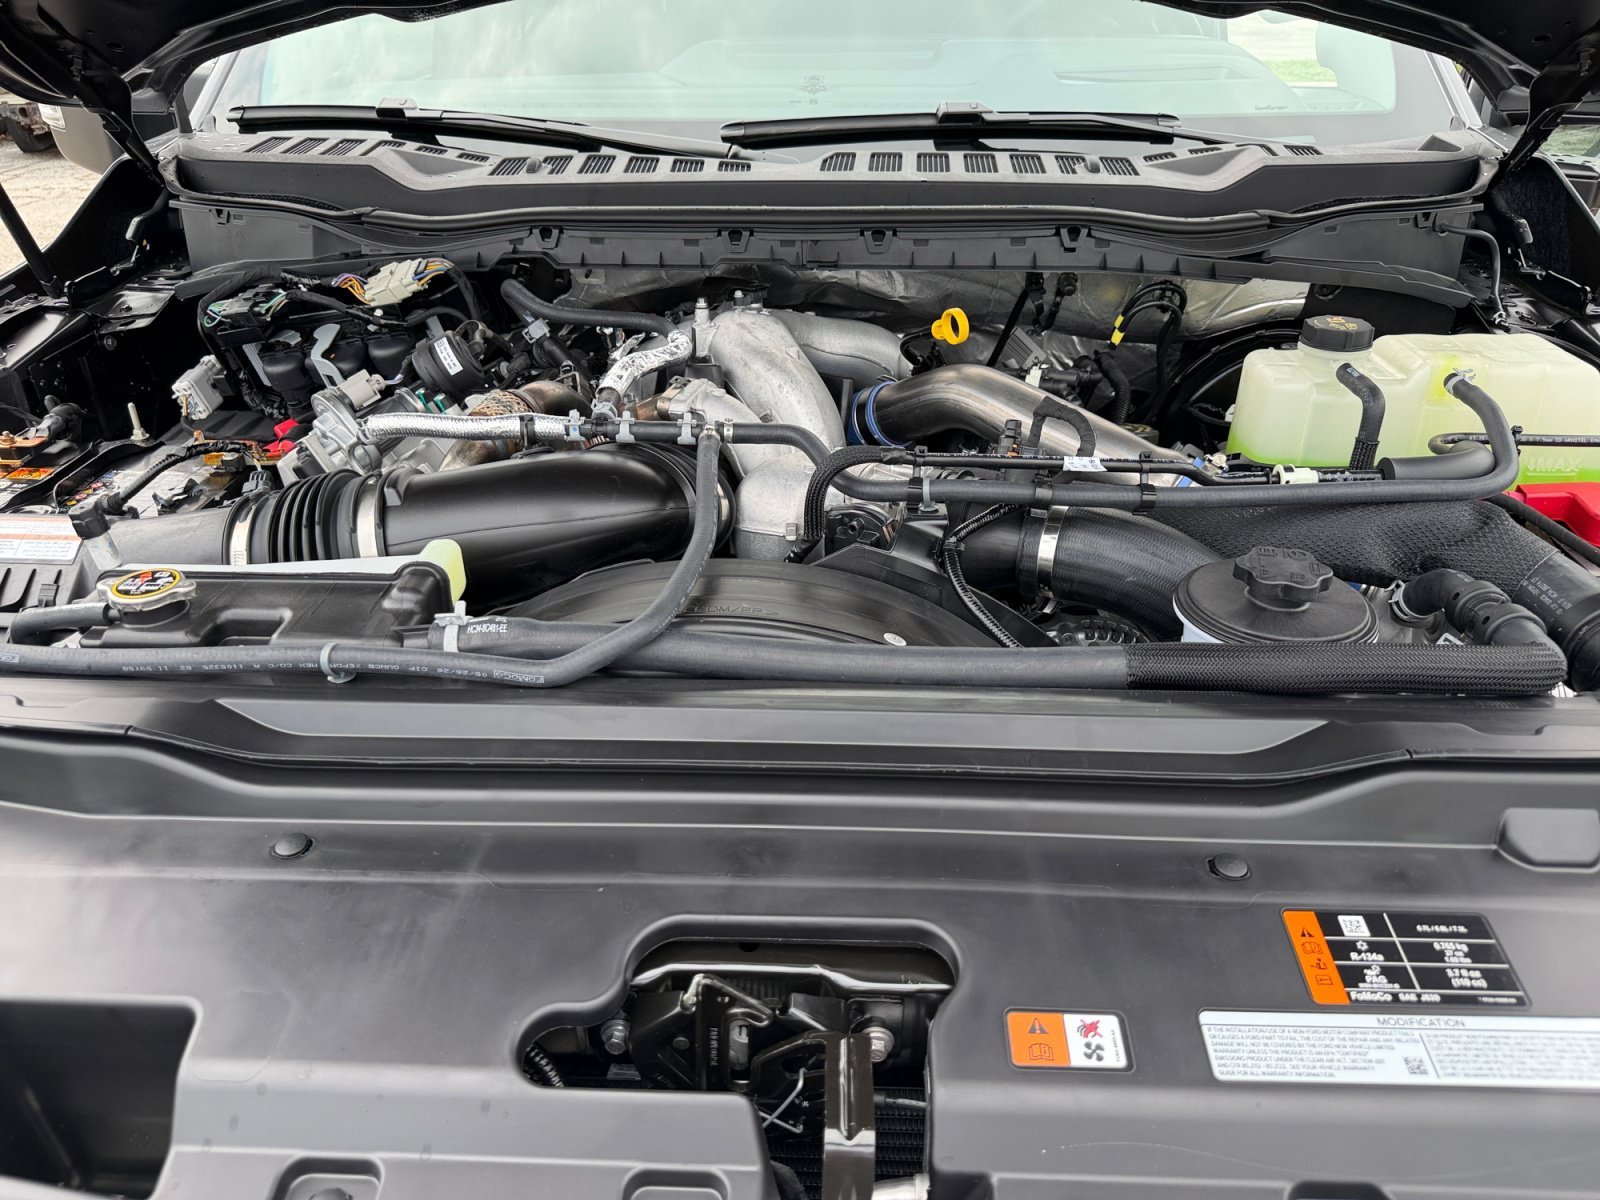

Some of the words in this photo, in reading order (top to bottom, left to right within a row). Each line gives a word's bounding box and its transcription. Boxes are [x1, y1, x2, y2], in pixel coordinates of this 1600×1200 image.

[1350, 951, 1385, 961] R-134a
[1365, 975, 1388, 984] PAG
[1350, 991, 1393, 1001] FoMoCo
[1376, 1017, 1466, 1028] MODIFICATION
